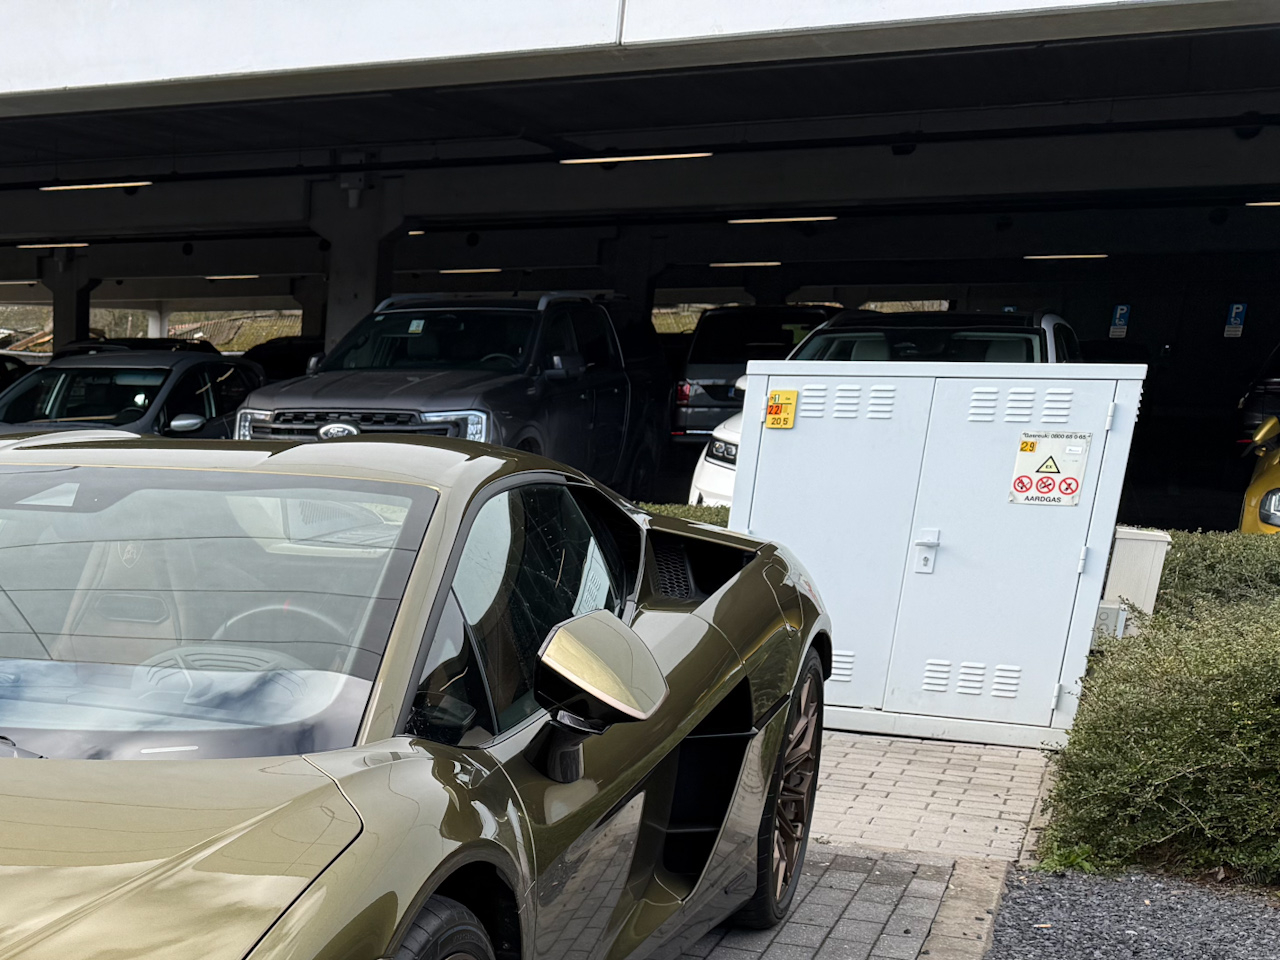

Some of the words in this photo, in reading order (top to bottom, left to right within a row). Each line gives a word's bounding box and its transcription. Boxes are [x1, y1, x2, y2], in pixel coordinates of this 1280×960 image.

[1116, 305, 1127, 318] P
[1231, 304, 1243, 318] P
[1020, 441, 1035, 452] 29
[1024, 495, 1062, 503] AARDGAS
